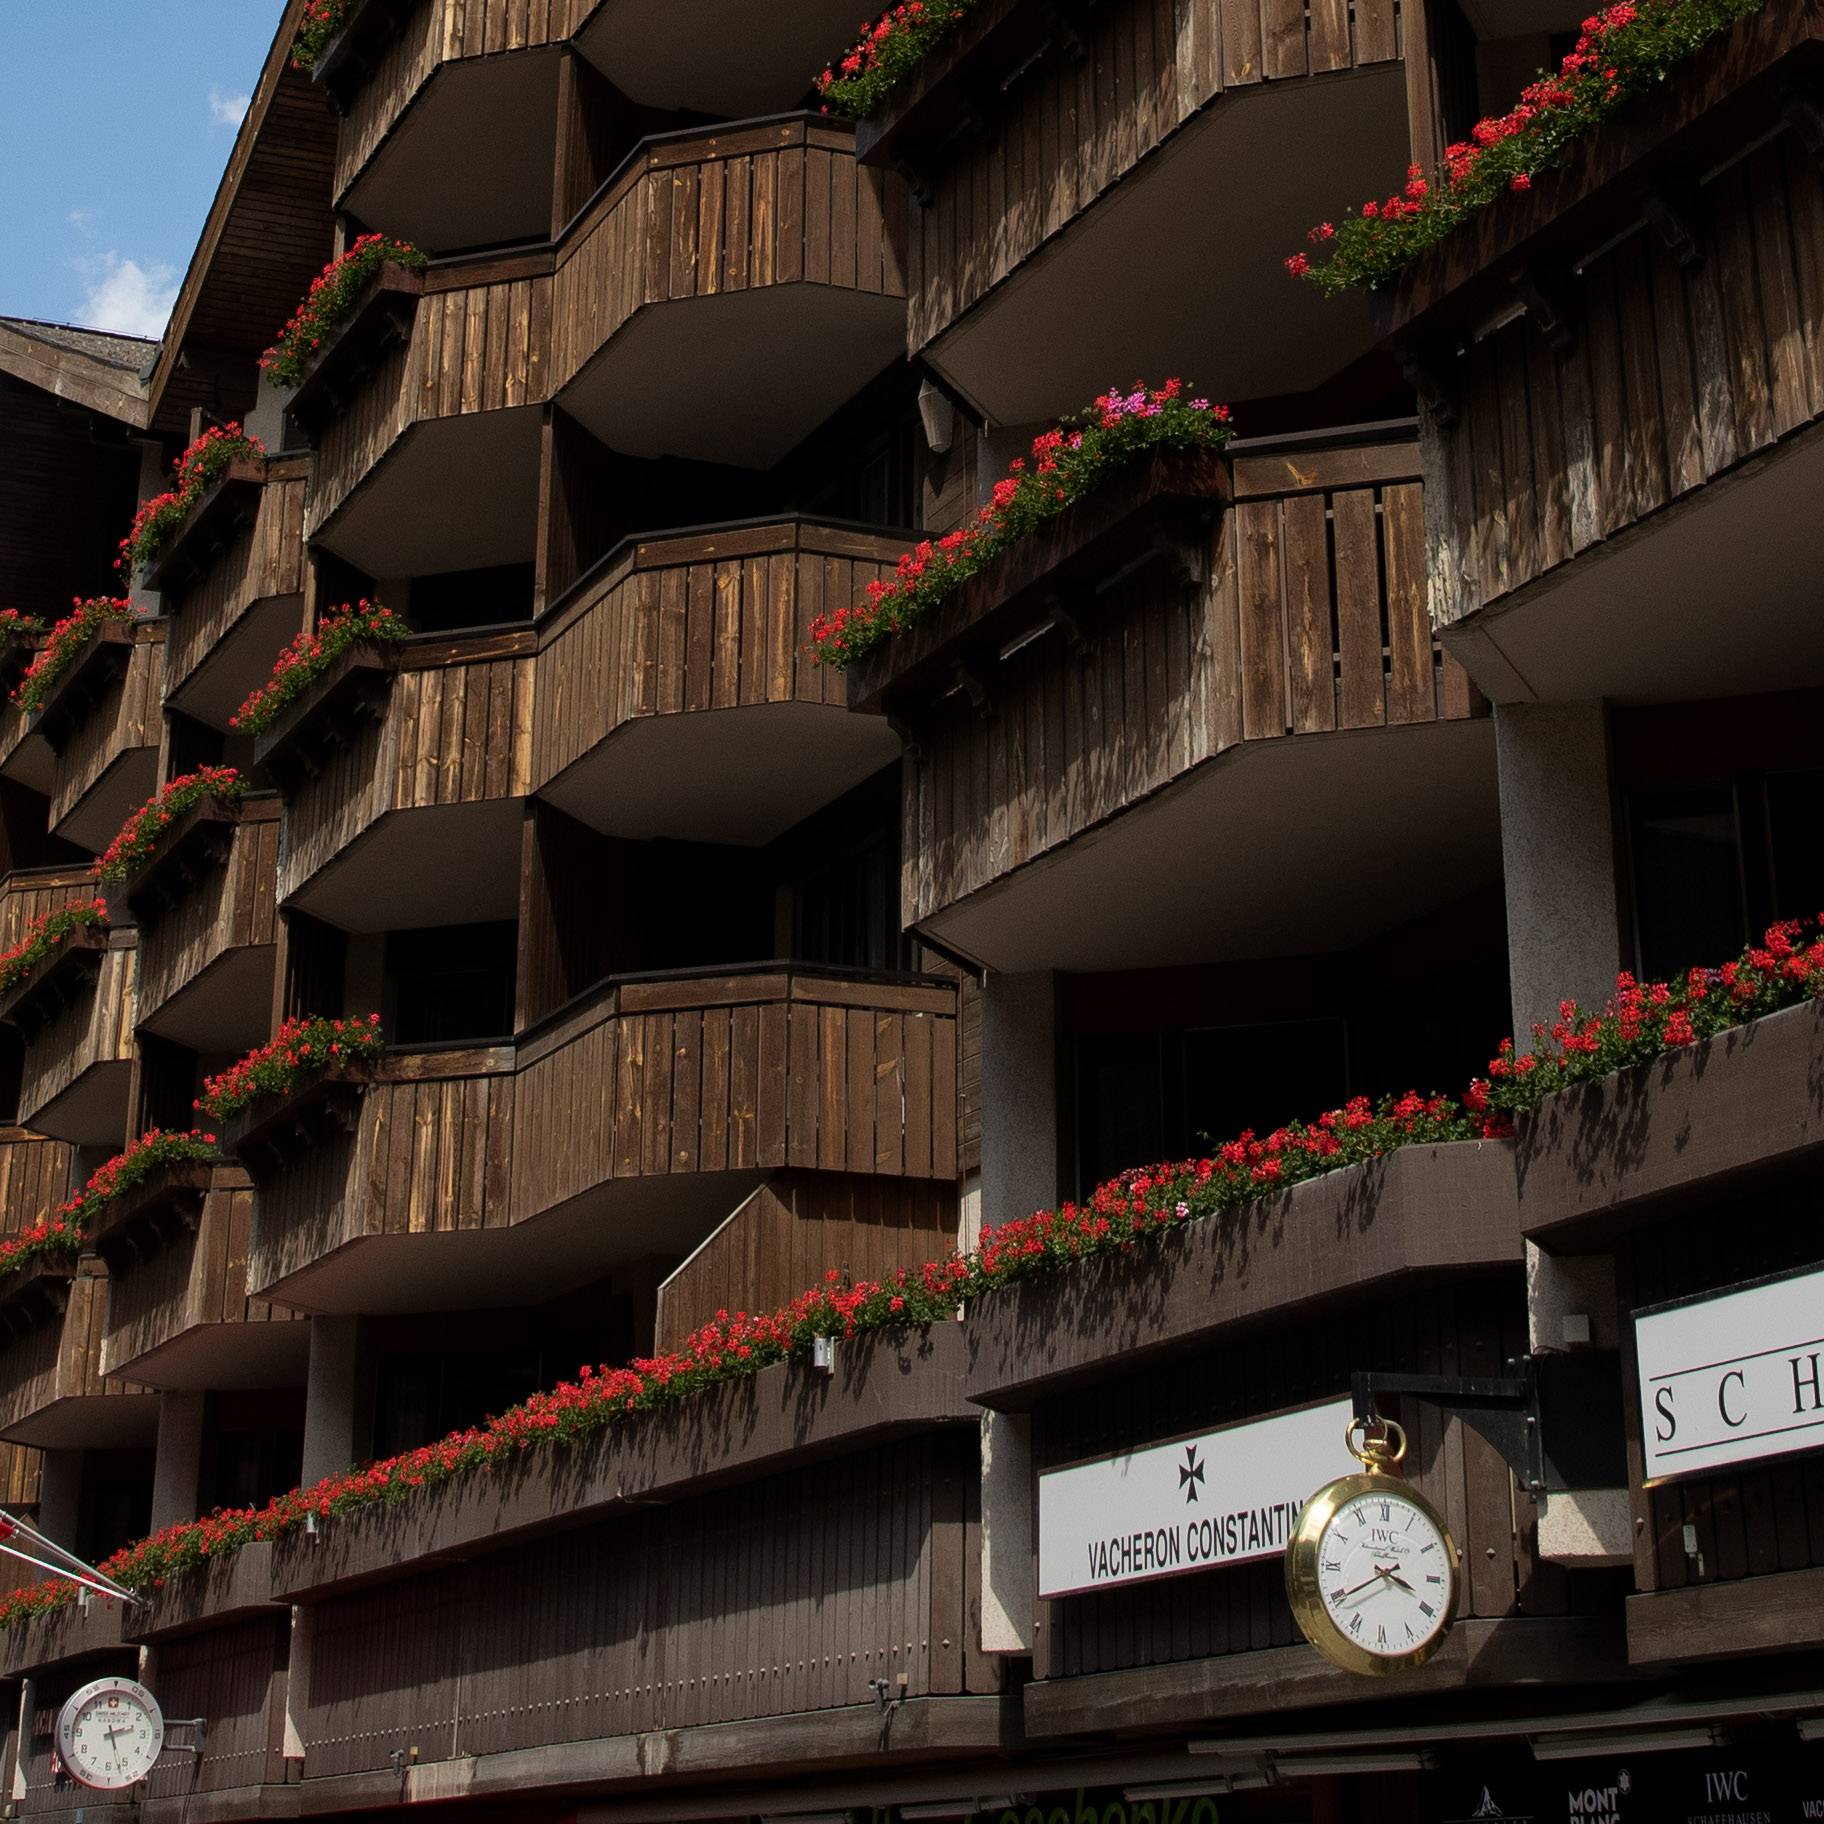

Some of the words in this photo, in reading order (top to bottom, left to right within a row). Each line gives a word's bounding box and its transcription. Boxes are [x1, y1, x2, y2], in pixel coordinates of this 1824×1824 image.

[1371, 1528, 1398, 1544] IWC
[1087, 1525, 1181, 1580] VACHERON
[82, 1712, 91, 1721] 10
[136, 1712, 142, 1721] 2
[76, 1728, 83, 1737] 9
[140, 1730, 145, 1739] 3
[81, 1744, 87, 1753] 8
[134, 1746, 140, 1754] 4
[91, 1757, 96, 1765] 7
[122, 1757, 128, 1766] 5
[105, 1762, 111, 1771] 6
[1705, 1771, 1749, 1803] IWC
[1568, 1787, 1618, 1814] MONT
